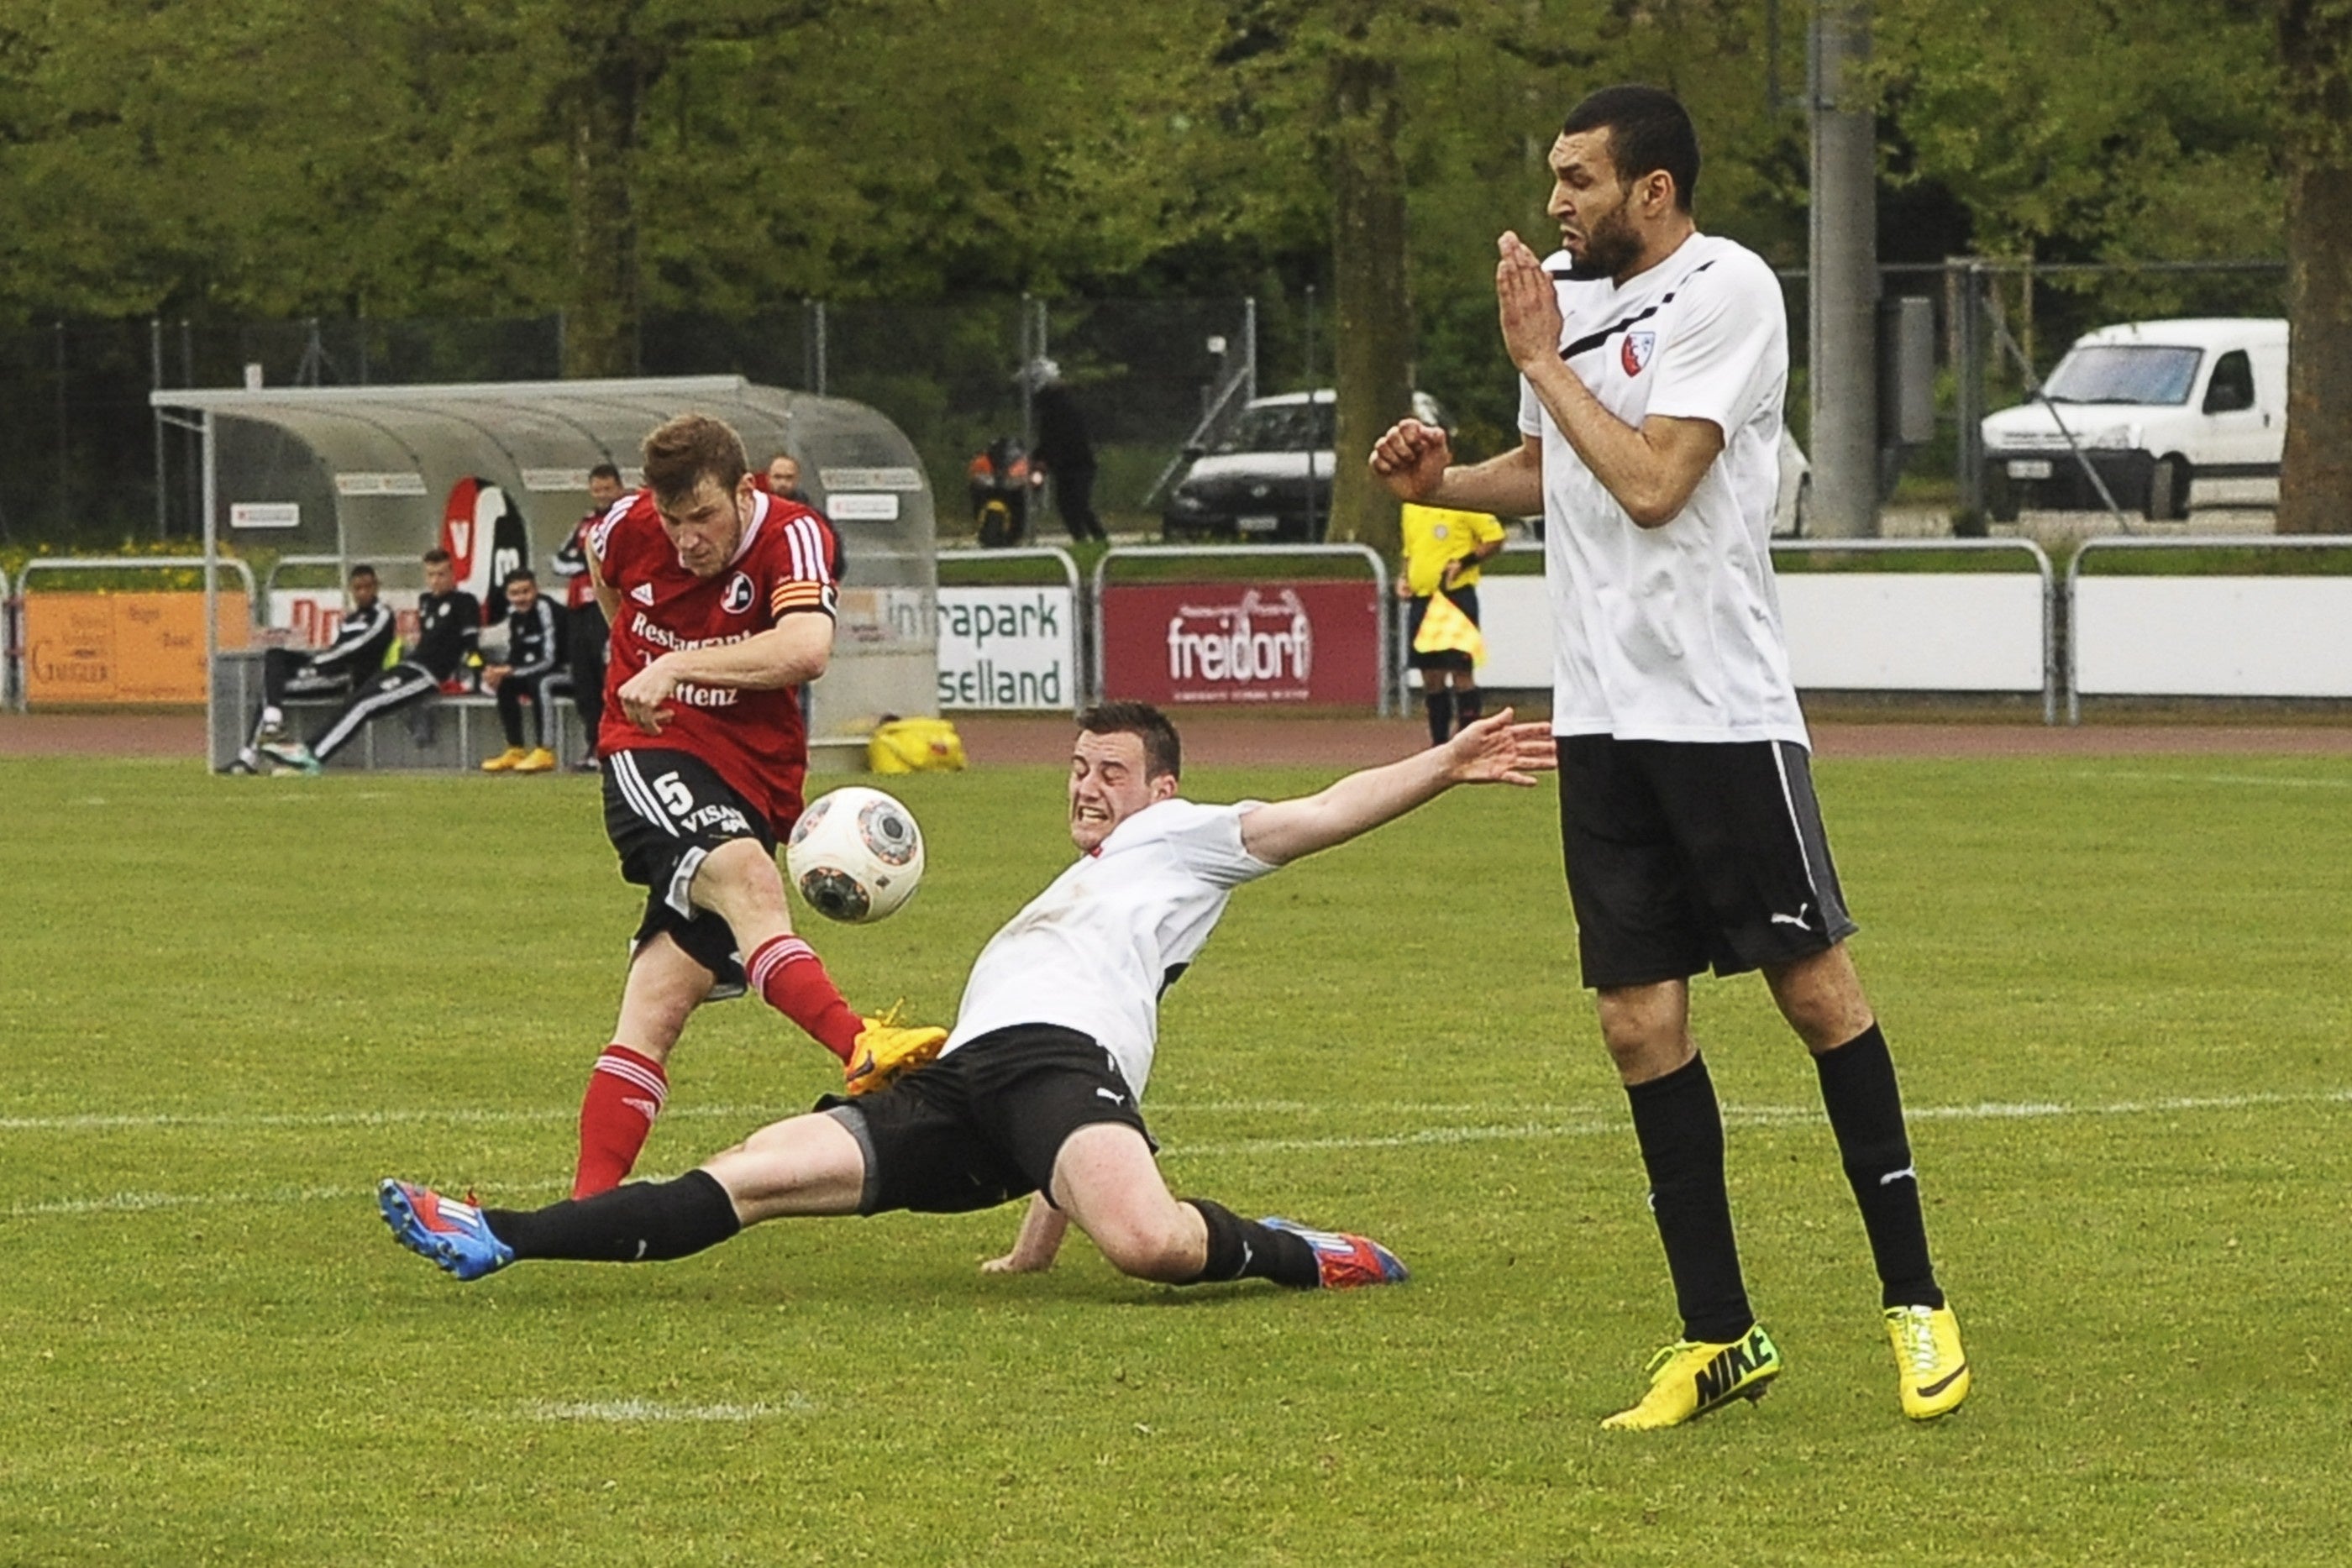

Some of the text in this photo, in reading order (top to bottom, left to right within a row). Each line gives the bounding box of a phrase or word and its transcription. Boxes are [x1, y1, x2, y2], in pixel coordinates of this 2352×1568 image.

[1168, 612, 1308, 681] freidorf
[653, 770, 694, 816] 5
[1694, 1329, 1773, 1408] NIKE
